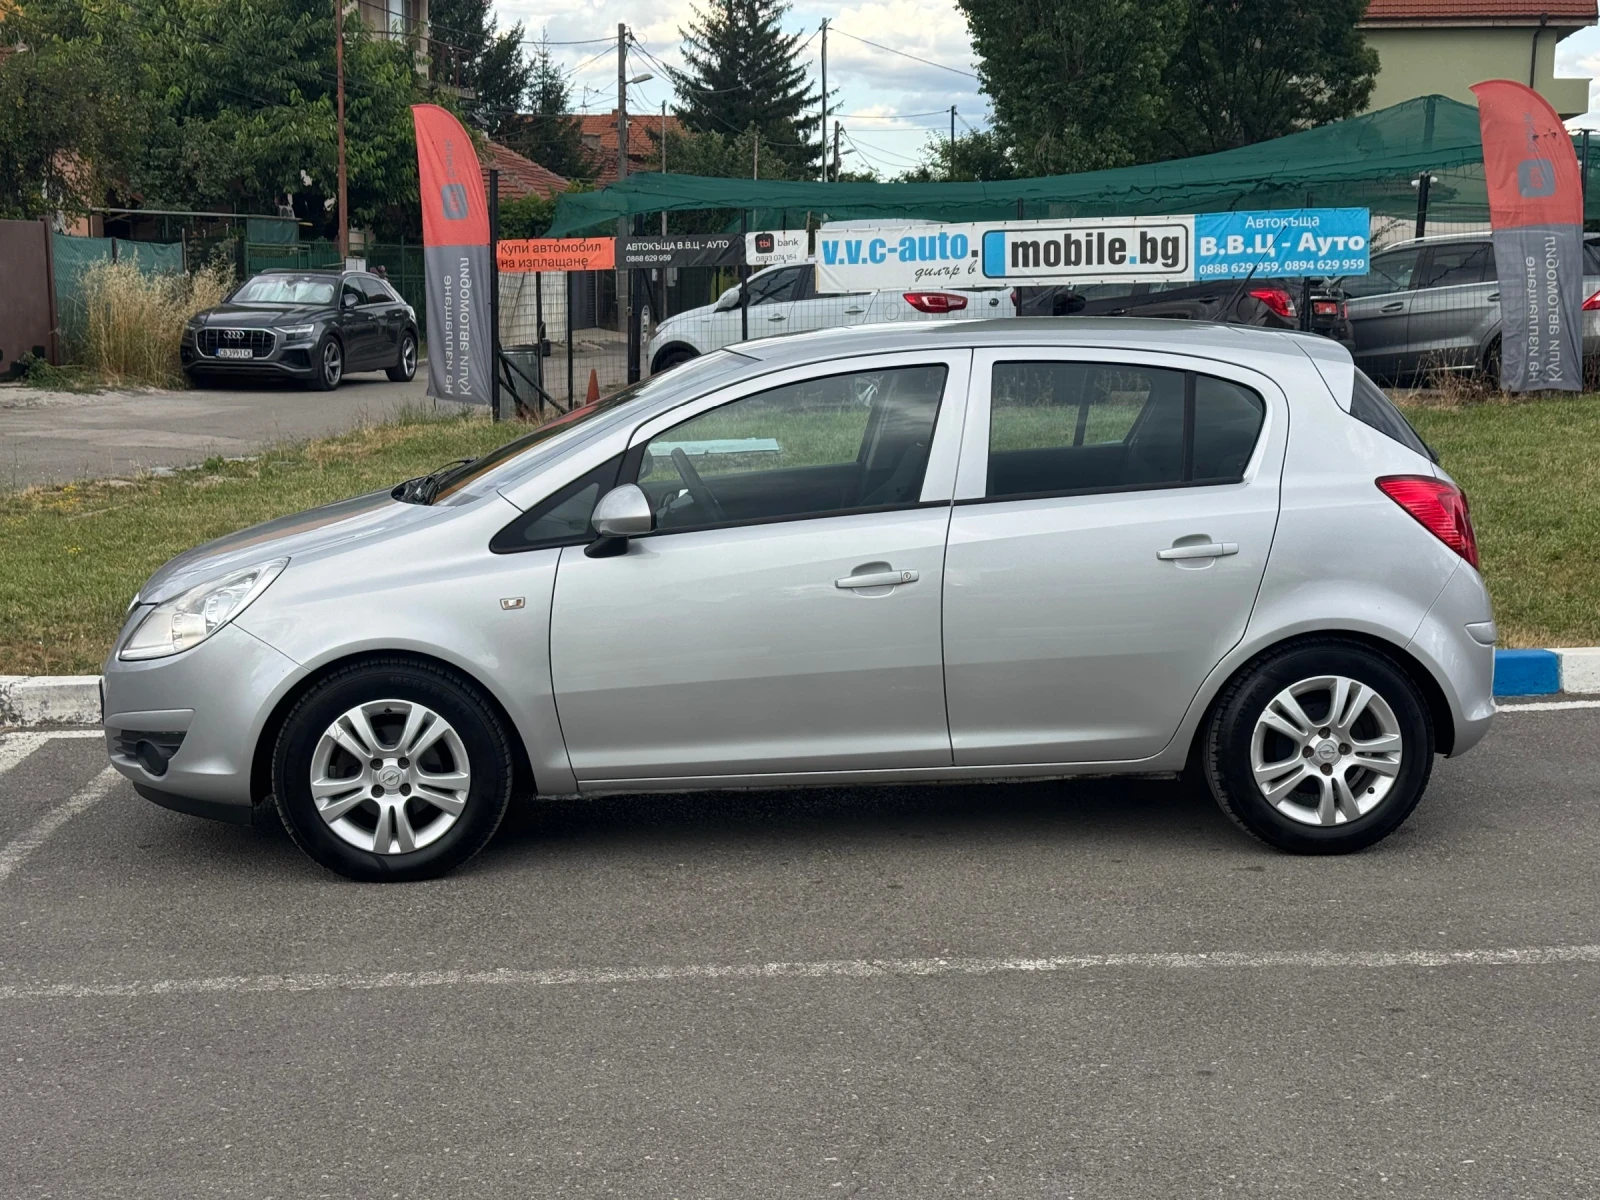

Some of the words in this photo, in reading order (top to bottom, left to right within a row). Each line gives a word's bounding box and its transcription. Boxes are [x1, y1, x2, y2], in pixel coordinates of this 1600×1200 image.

[1245, 216, 1320, 229] Автокъща
[500, 243, 529, 256] Купи
[532, 242, 601, 253] автомобил
[625, 241, 675, 251] АВТОКЪЩА
[706, 240, 729, 249] АУТО
[777, 238, 799, 247] bank
[1200, 233, 1276, 257] В.В.Ц
[1297, 232, 1365, 257] Ауто
[1011, 231, 1180, 268] mobile.bg
[501, 259, 515, 268] на
[518, 257, 589, 268] изплащане
[645, 254, 658, 262] 629
[658, 254, 672, 262] 959
[1199, 263, 1229, 274] 0888
[1231, 262, 1254, 273] 629
[1284, 260, 1315, 271] 0894
[1317, 259, 1340, 270] 629
[1342, 258, 1365, 269] 959
